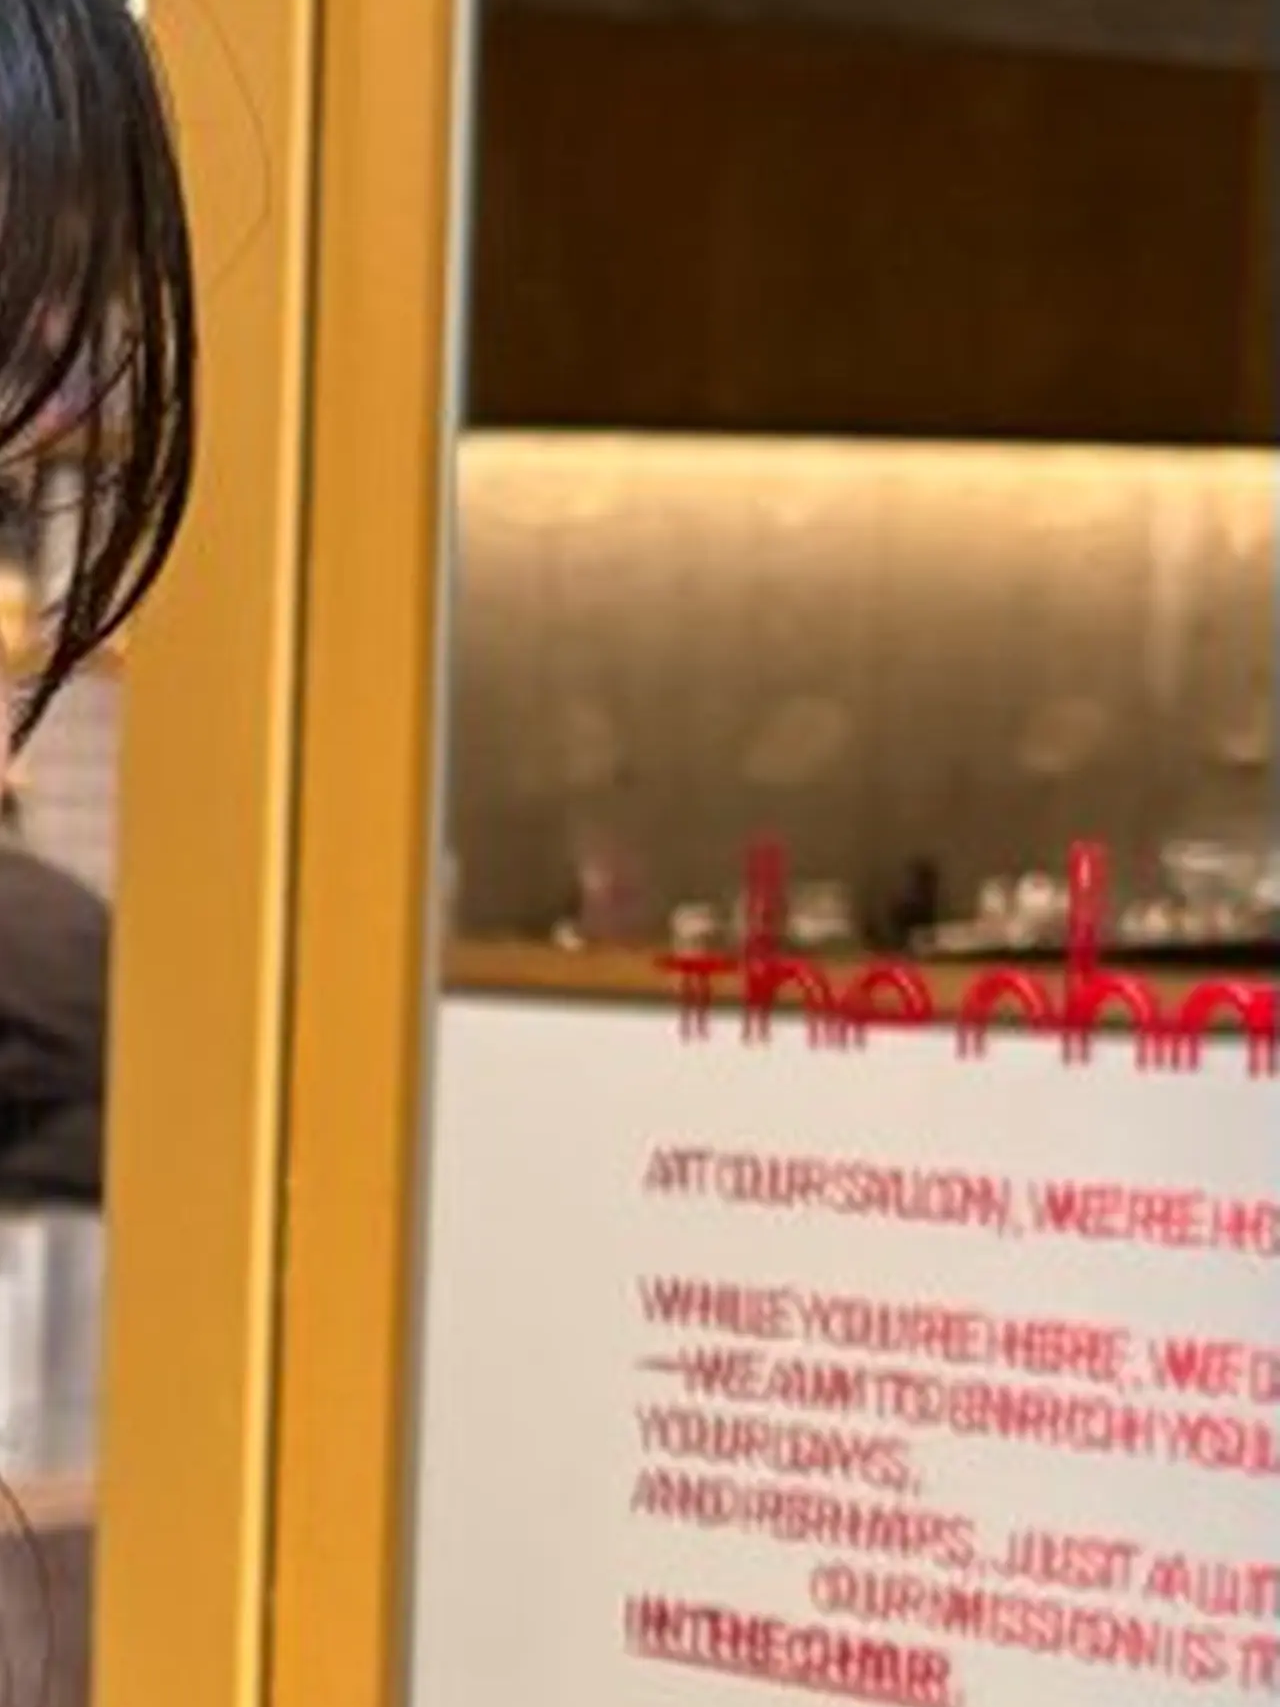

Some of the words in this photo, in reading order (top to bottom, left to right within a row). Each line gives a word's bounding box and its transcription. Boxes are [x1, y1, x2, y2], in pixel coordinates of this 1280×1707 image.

[643, 1145, 713, 1196] AT
[715, 1150, 828, 1209] OUR
[638, 1275, 795, 1341] WHILE
[1147, 1335, 1244, 1396] WE
[637, 1403, 773, 1467] YOUR
[766, 1357, 867, 1413] AIM
[870, 1371, 948, 1424] TO
[948, 1383, 1155, 1458] ENRICH
[629, 1468, 740, 1529] AND
[996, 1527, 1142, 1593] JUST
[1142, 1551, 1190, 1598] A
[624, 1594, 686, 1654] IN
[686, 1605, 786, 1671] THE
[807, 1561, 928, 1623] OUR
[929, 1585, 1160, 1671] MISSION
[1164, 1625, 1231, 1683] IS
